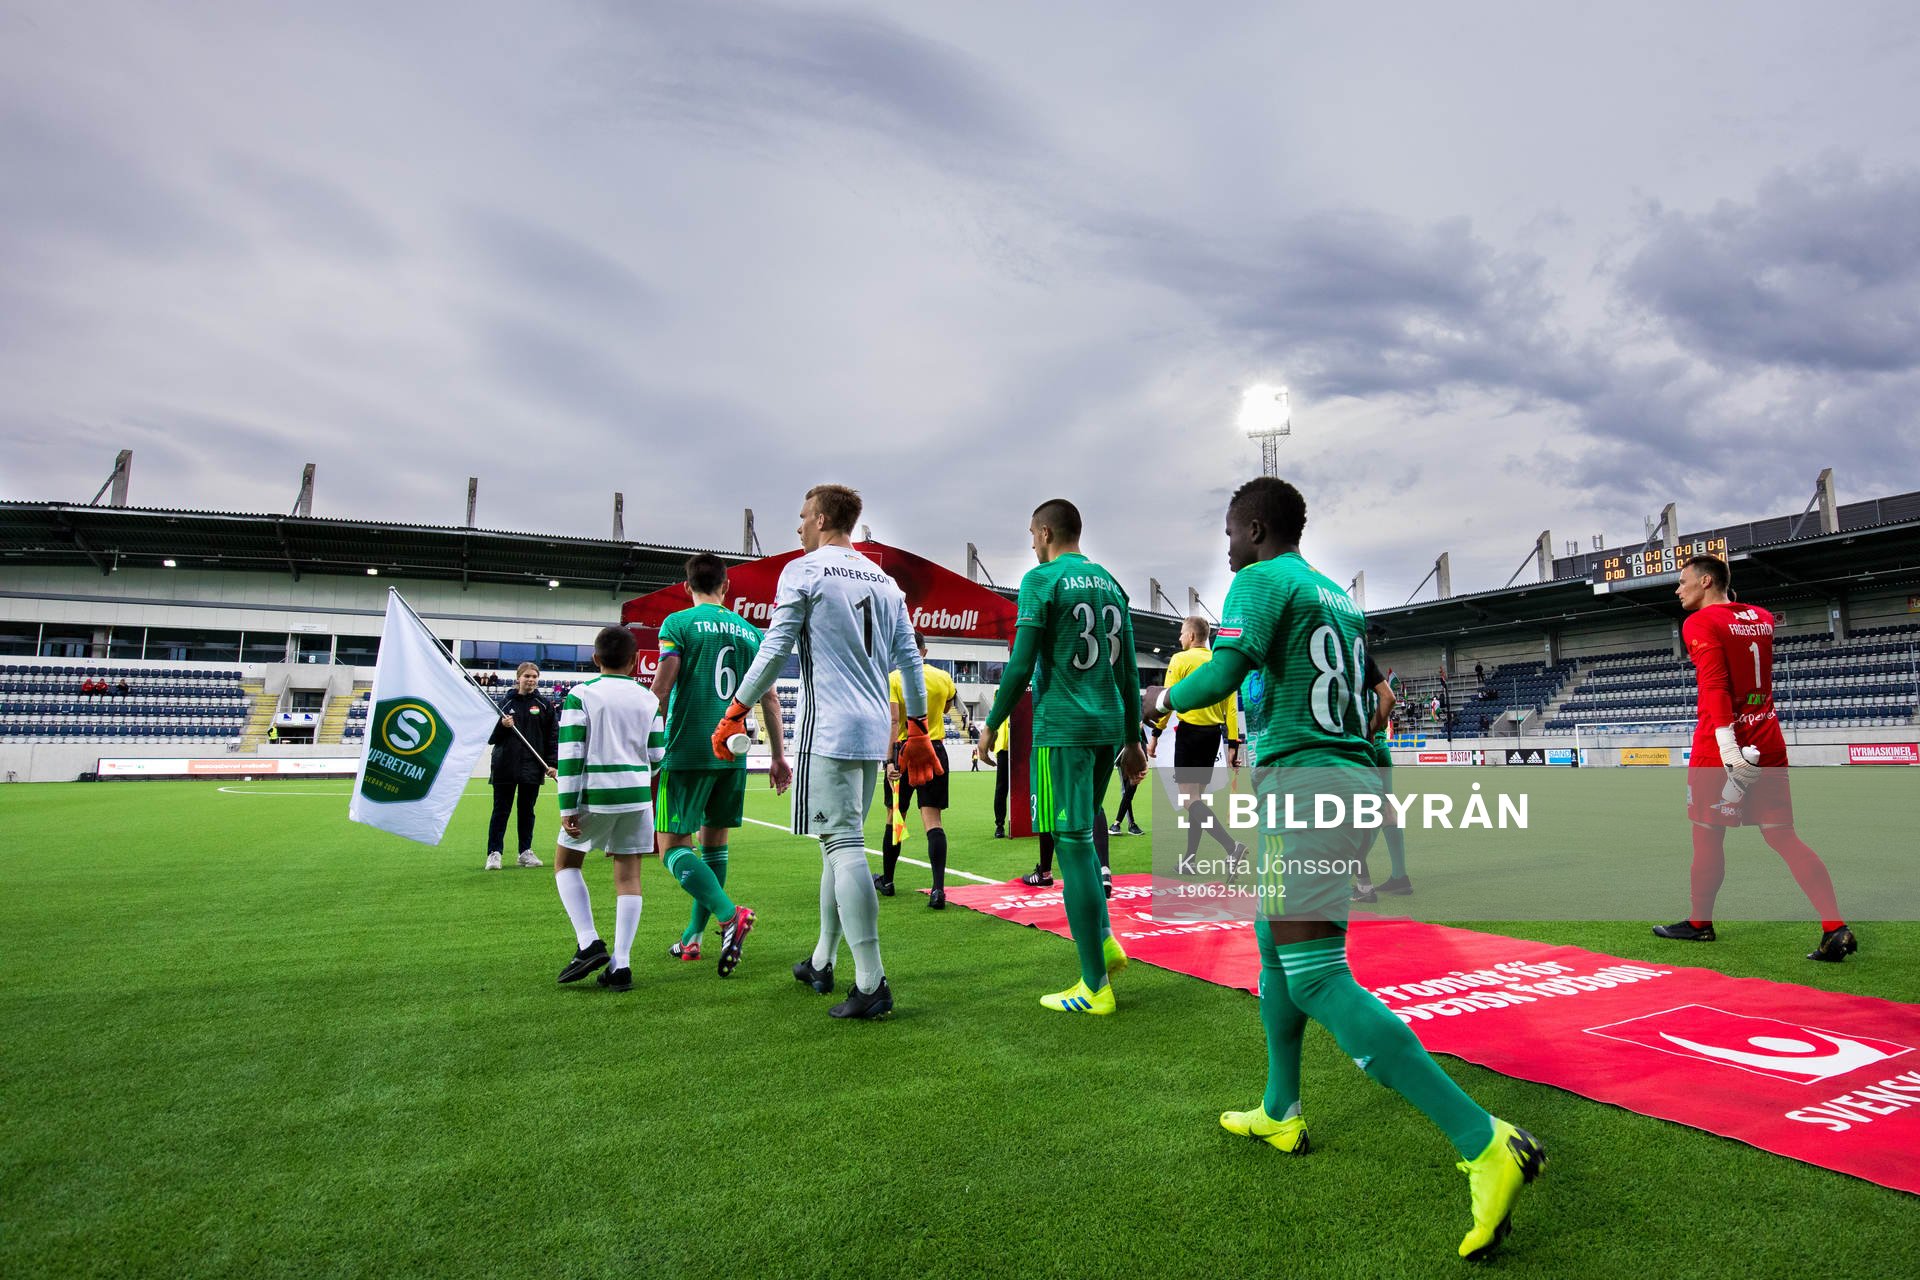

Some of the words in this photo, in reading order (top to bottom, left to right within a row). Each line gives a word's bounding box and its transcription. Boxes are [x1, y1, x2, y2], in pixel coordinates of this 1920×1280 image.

[1634, 554, 1642, 564] A
[1664, 548, 1672, 558] C
[1696, 543, 1704, 553] E
[823, 566, 891, 585] ANDERSSON
[1636, 566, 1643, 575] B
[1665, 561, 1673, 571] D
[733, 597, 774, 620] Fra
[912, 607, 979, 631] fotboll!
[694, 621, 756, 643] TRANBERG
[855, 595, 873, 659] 1
[1072, 602, 1122, 670] 33
[714, 645, 737, 701] 6
[1749, 641, 1761, 689] 1
[388, 709, 428, 750] S
[367, 748, 427, 780] UPERETTAN
[990, 898, 1065, 910] sven
[1494, 960, 1575, 978] för
[1504, 964, 1673, 998] fotboll!
